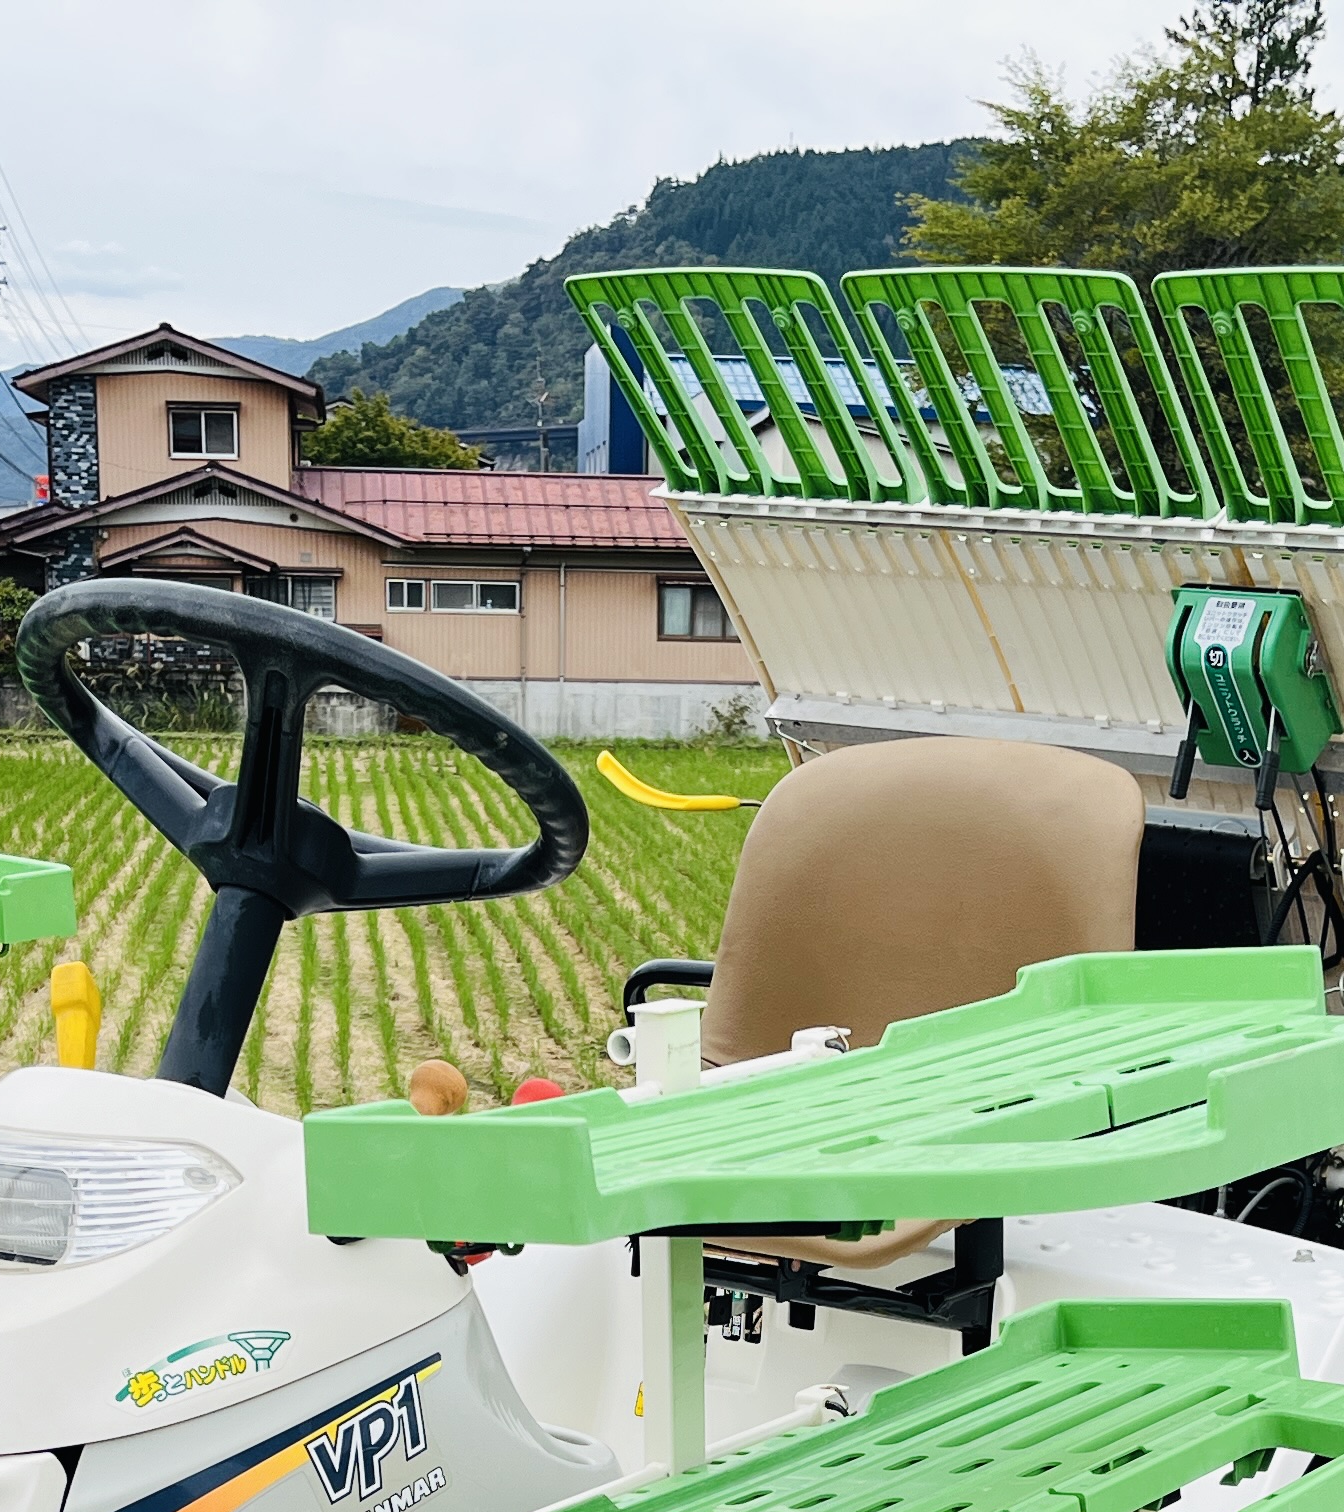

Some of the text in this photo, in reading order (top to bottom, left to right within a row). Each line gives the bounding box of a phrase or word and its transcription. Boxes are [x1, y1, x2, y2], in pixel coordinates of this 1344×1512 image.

[1208, 649, 1224, 667] 切
[1242, 749, 1257, 762] 入
[128, 1354, 246, 1407] 歩っとハンドル
[304, 1373, 428, 1505] VP1
